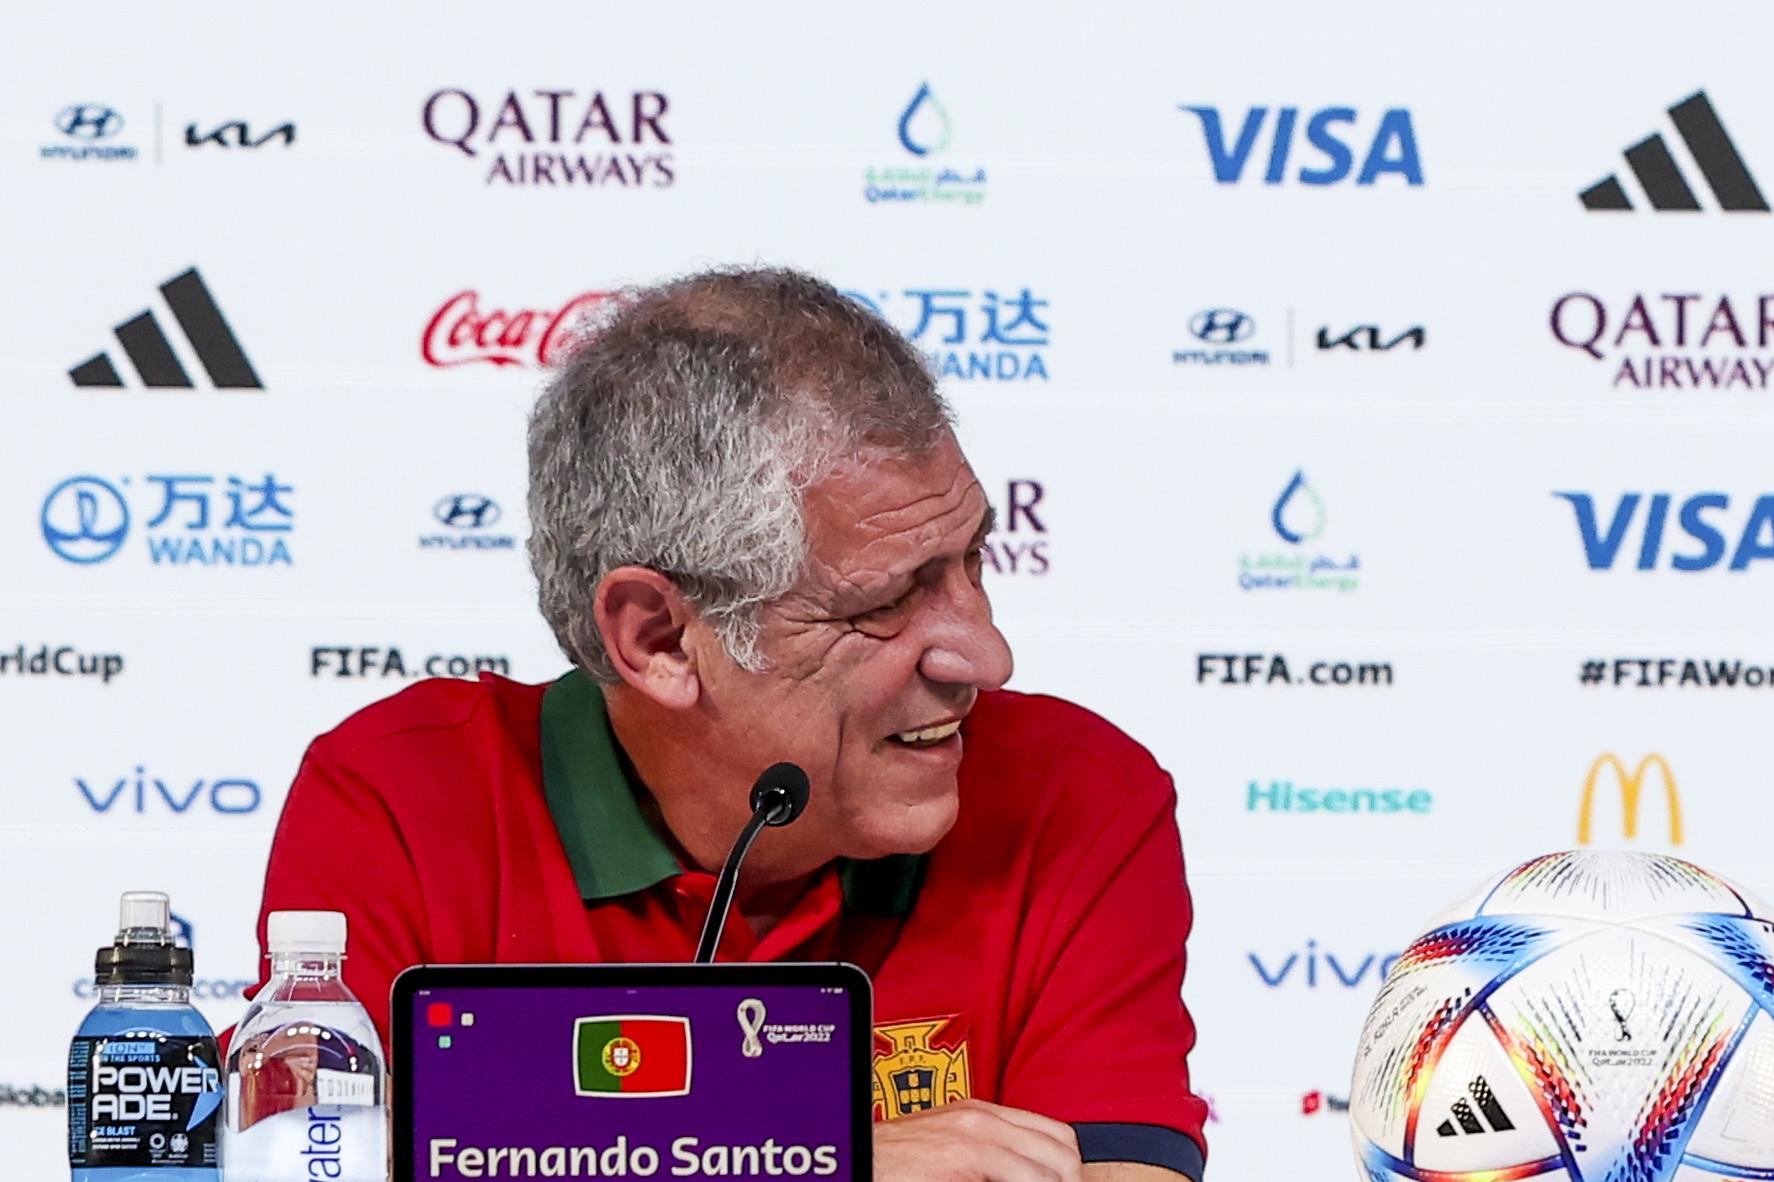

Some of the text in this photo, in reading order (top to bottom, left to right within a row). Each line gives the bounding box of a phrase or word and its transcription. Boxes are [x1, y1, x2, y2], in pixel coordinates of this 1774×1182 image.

[422, 88, 673, 156] QATAR
[1178, 105, 1425, 185] VISA
[487, 156, 675, 187] AIRWAYS
[901, 287, 1048, 345] 万达
[935, 352, 1050, 381] ANDA
[146, 473, 295, 531] 万达
[148, 537, 293, 566] WANDA
[310, 647, 510, 678] FIFA.com
[1197, 654, 1394, 687] FIFA.com
[73, 766, 263, 814] vivo
[1246, 779, 1434, 814] Hisense
[127, 1055, 160, 1063] SPORTS
[92, 1066, 220, 1093] POWER
[92, 1094, 178, 1121] ADE.
[106, 1126, 136, 1136] BLAST
[429, 1136, 837, 1178] Fernando Santos
